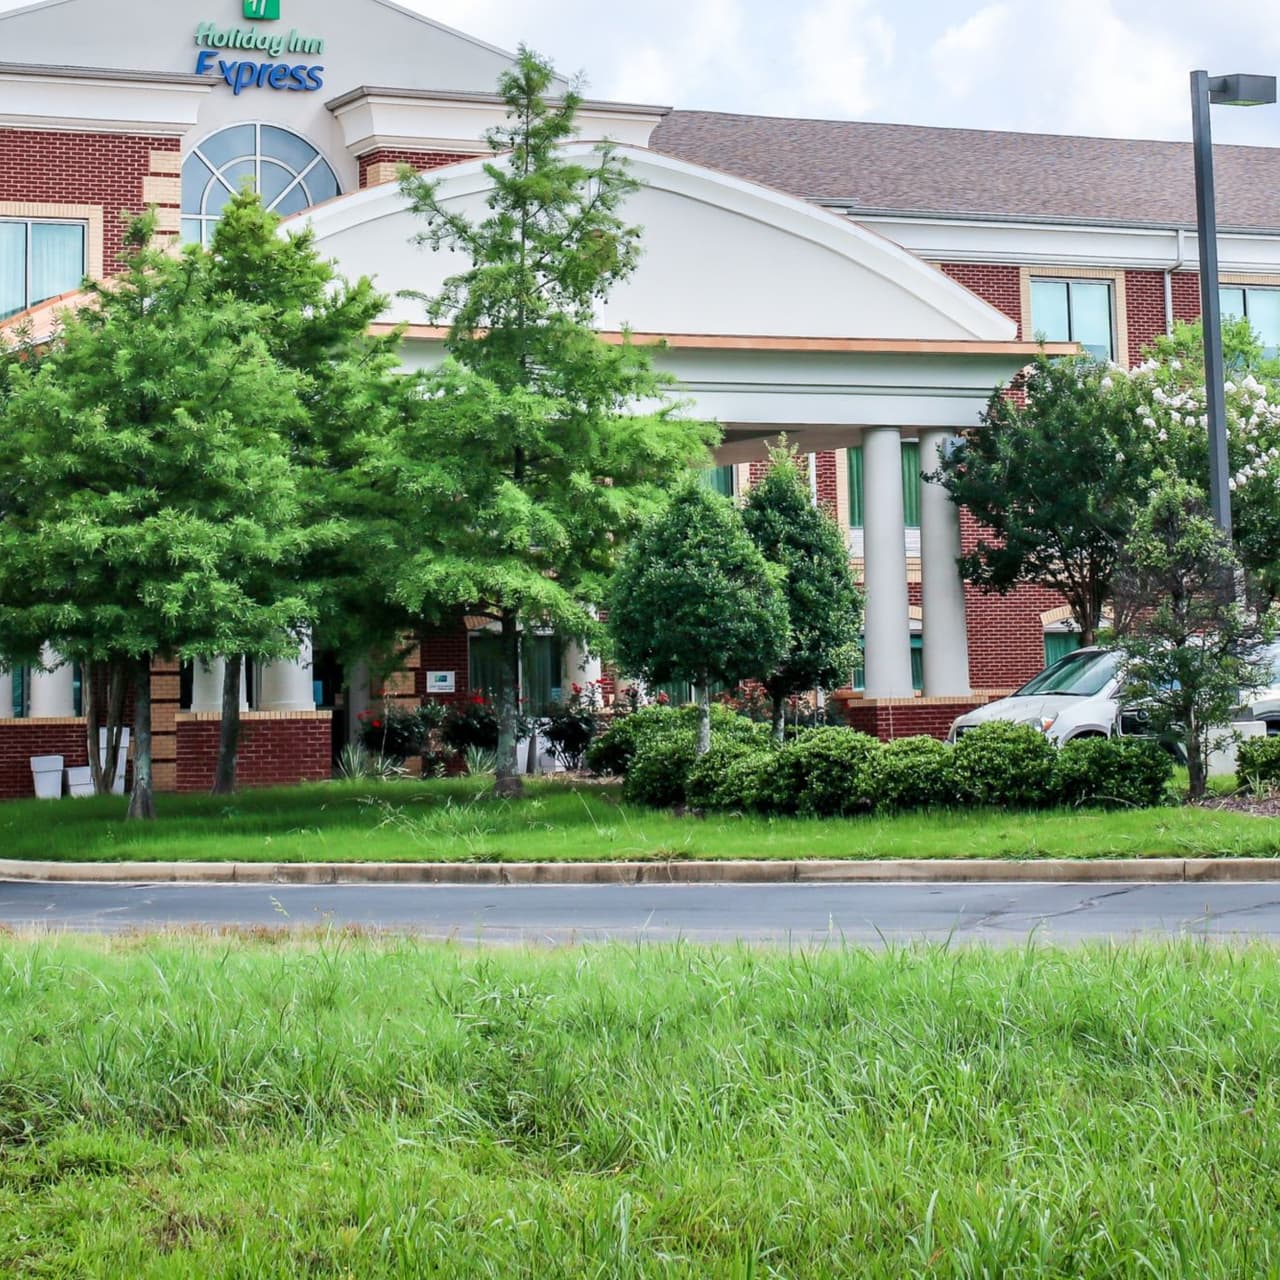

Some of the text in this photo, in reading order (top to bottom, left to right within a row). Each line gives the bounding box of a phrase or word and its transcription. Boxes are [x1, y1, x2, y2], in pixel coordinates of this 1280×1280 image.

[194, 22, 325, 58] Holiday Inn
[195, 51, 325, 96] Express
